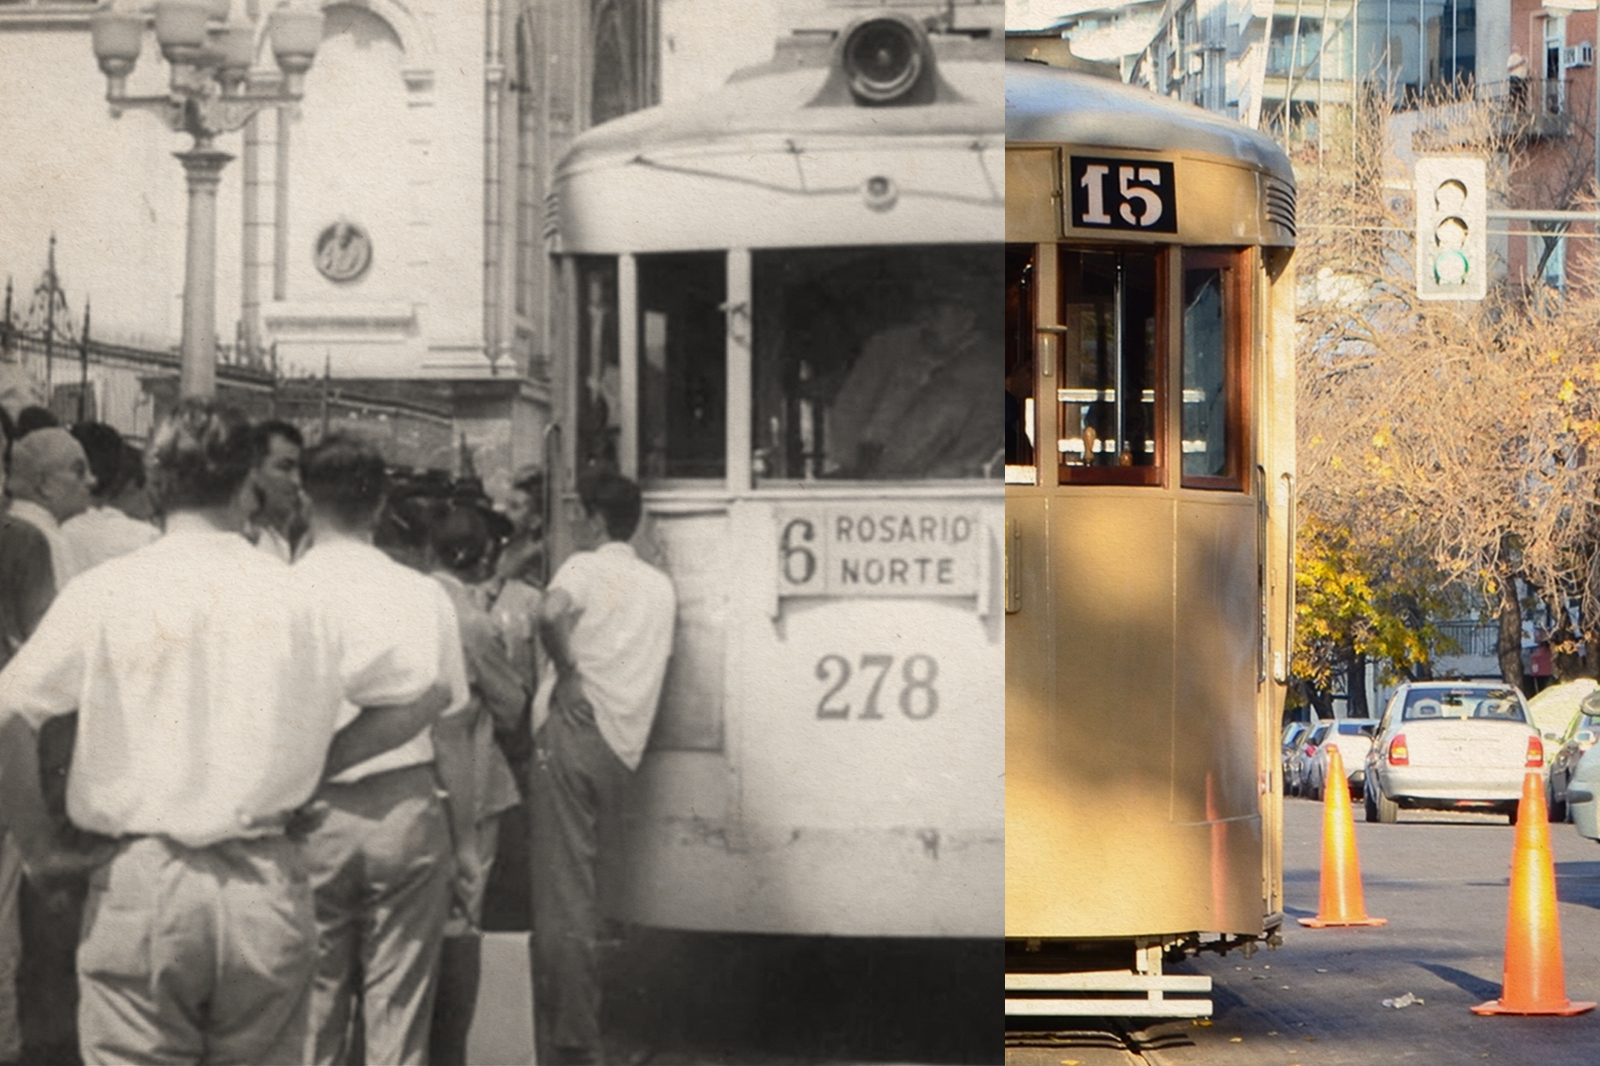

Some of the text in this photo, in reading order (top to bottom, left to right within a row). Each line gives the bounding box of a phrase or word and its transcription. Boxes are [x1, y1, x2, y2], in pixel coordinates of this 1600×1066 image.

[1080, 164, 1163, 227] 15
[779, 518, 817, 585] 6
[836, 515, 972, 543] ROSARIO
[841, 558, 955, 584] NORTE
[815, 654, 939, 721] 278
